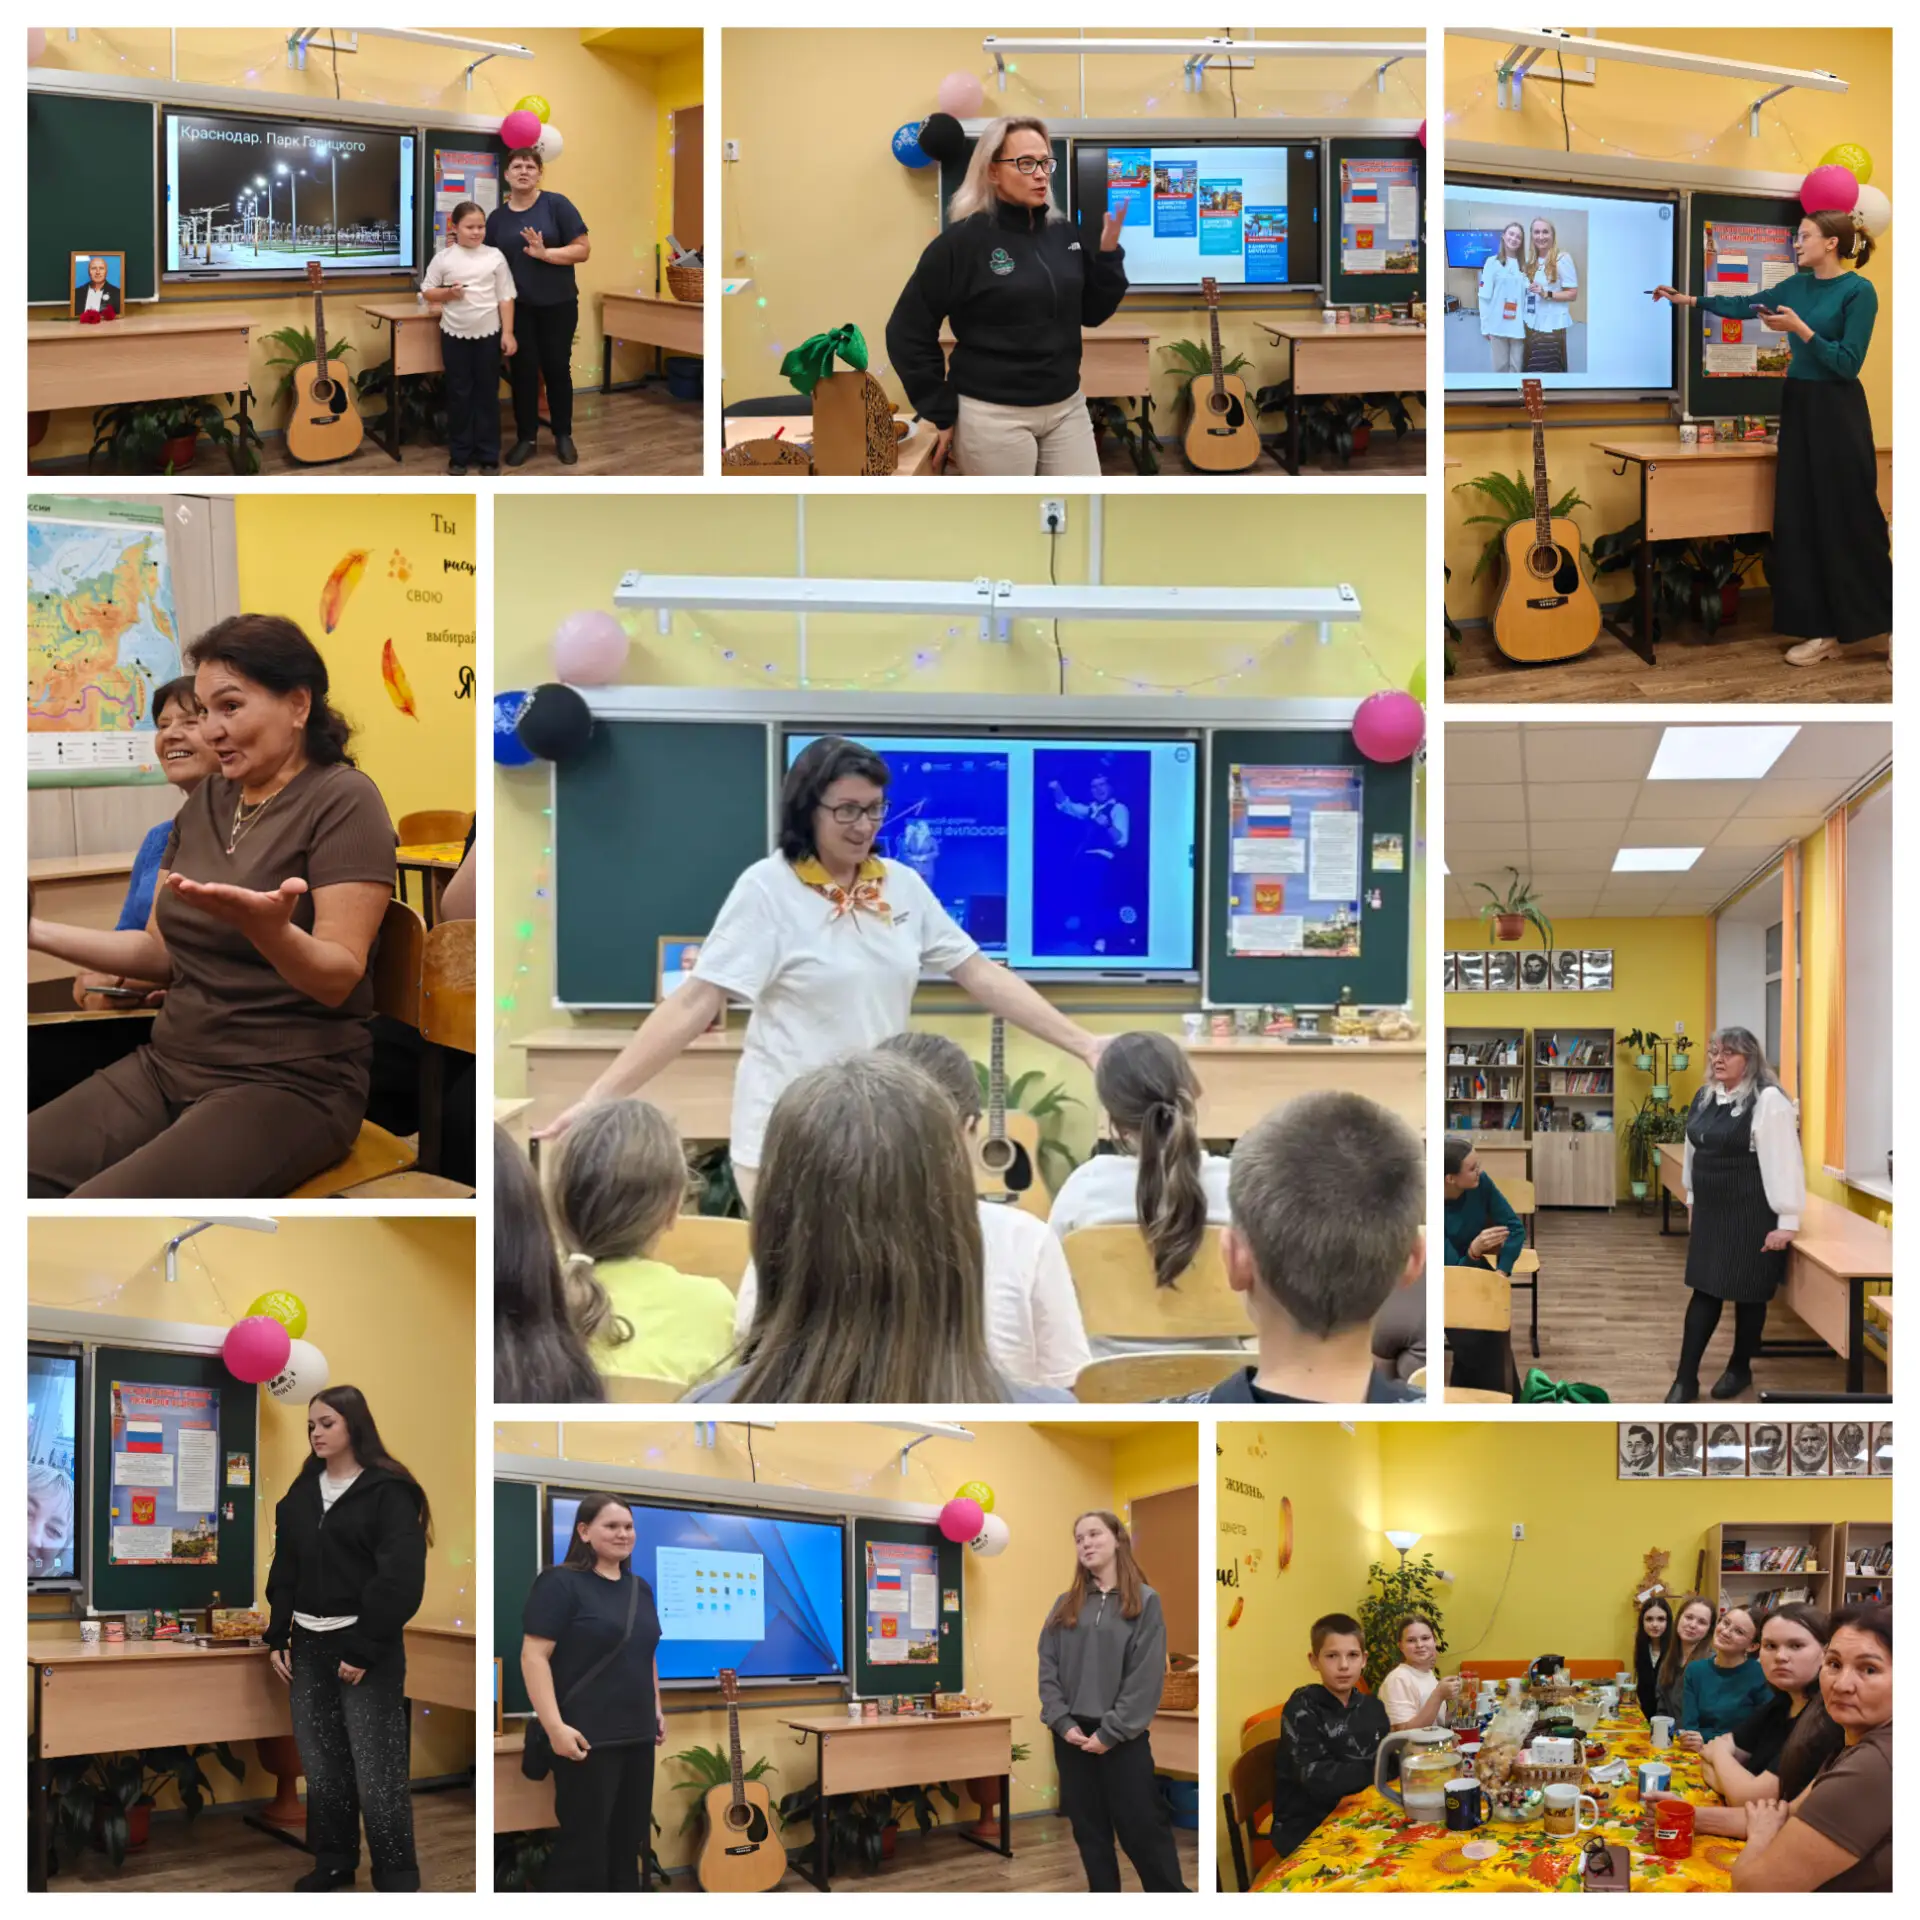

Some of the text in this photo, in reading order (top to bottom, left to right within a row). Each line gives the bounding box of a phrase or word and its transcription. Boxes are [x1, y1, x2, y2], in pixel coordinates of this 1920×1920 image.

[181, 125, 366, 153] Краснодар. Парк Галицкого
[431, 512, 456, 536] Ты
[443, 558, 476, 577] рису
[406, 588, 443, 604] свою
[454, 665, 476, 702] Я
[1220, 1521, 1247, 1537] цвета
